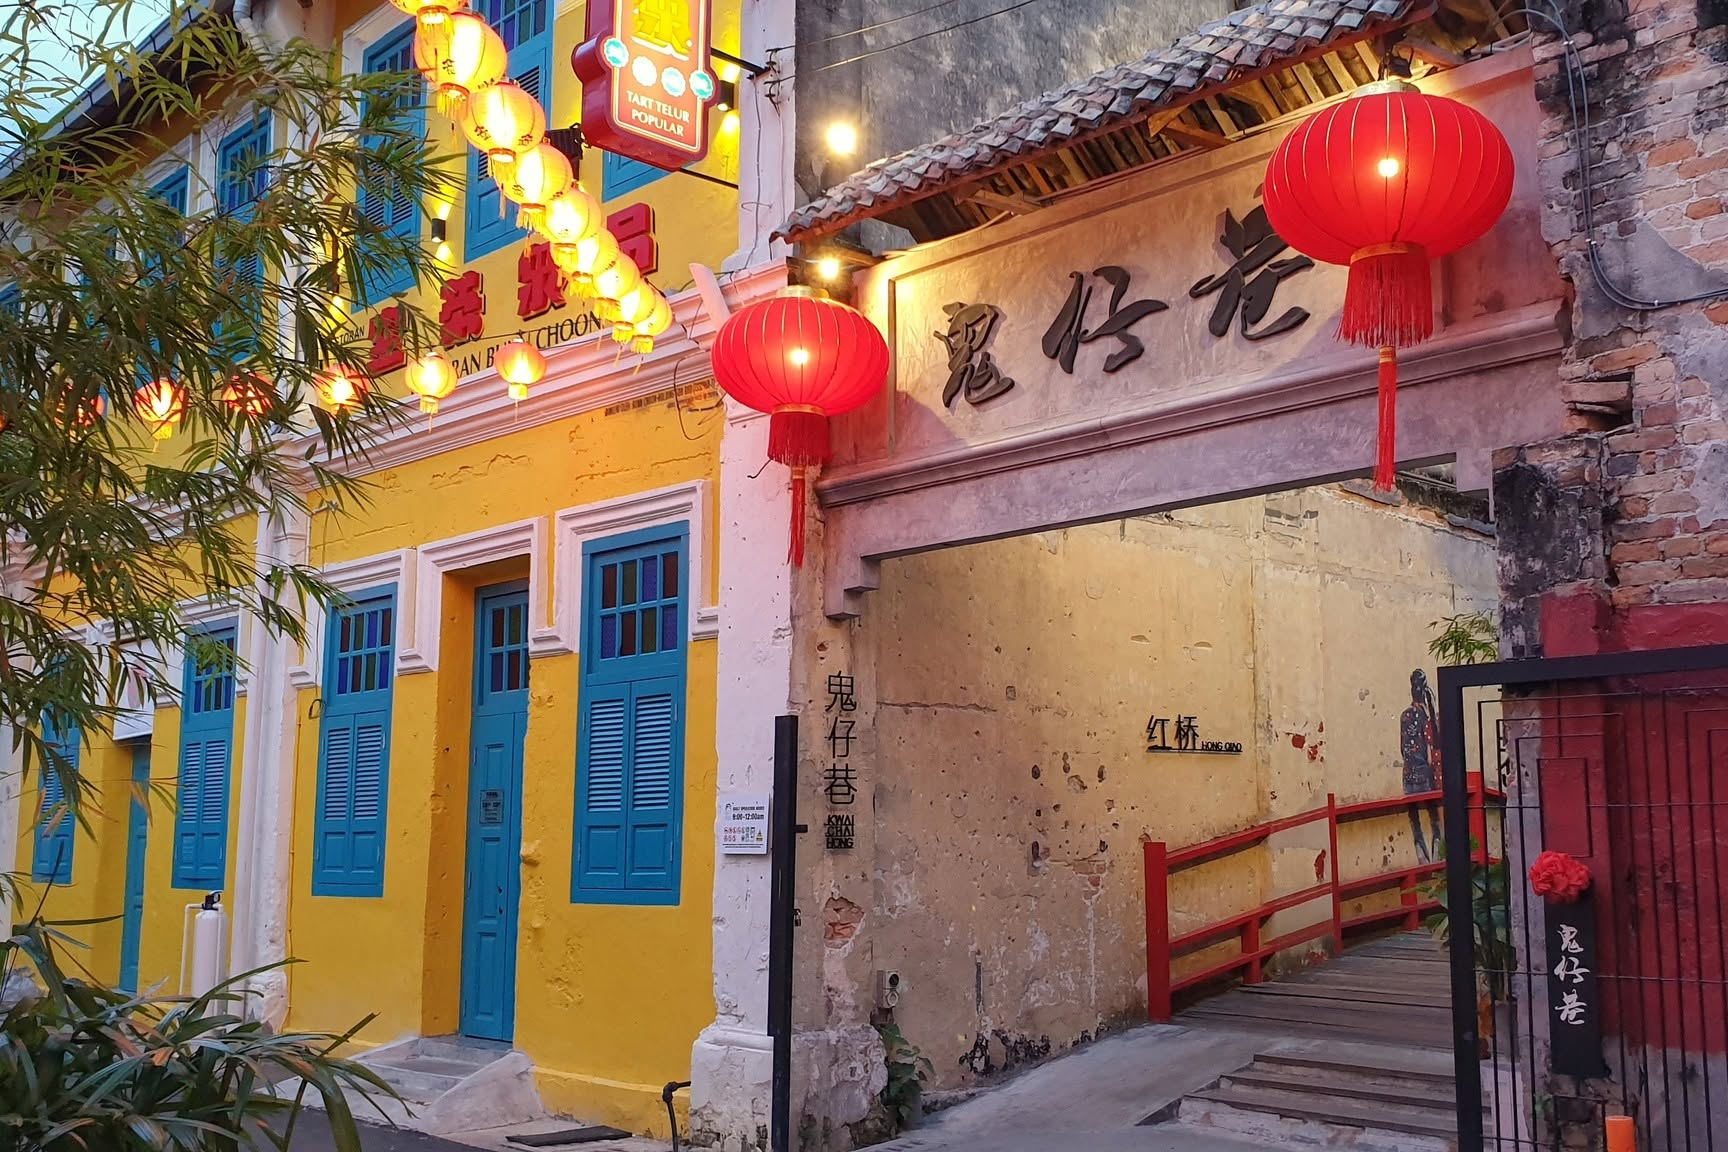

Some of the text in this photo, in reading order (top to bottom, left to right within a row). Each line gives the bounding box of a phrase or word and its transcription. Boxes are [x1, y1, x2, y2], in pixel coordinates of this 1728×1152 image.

[626, 90, 690, 122] TART TELUR
[631, 109, 684, 136] POPULAR
[824, 670, 858, 805] 鬼仔巷
[1146, 714, 1200, 750] 红桥
[1201, 741, 1223, 751] HONG
[825, 814, 855, 826] KWAI
[825, 826, 855, 837] CHAI
[826, 838, 854, 849] HONG
[1553, 923, 1591, 1025] 鬼仔巷
